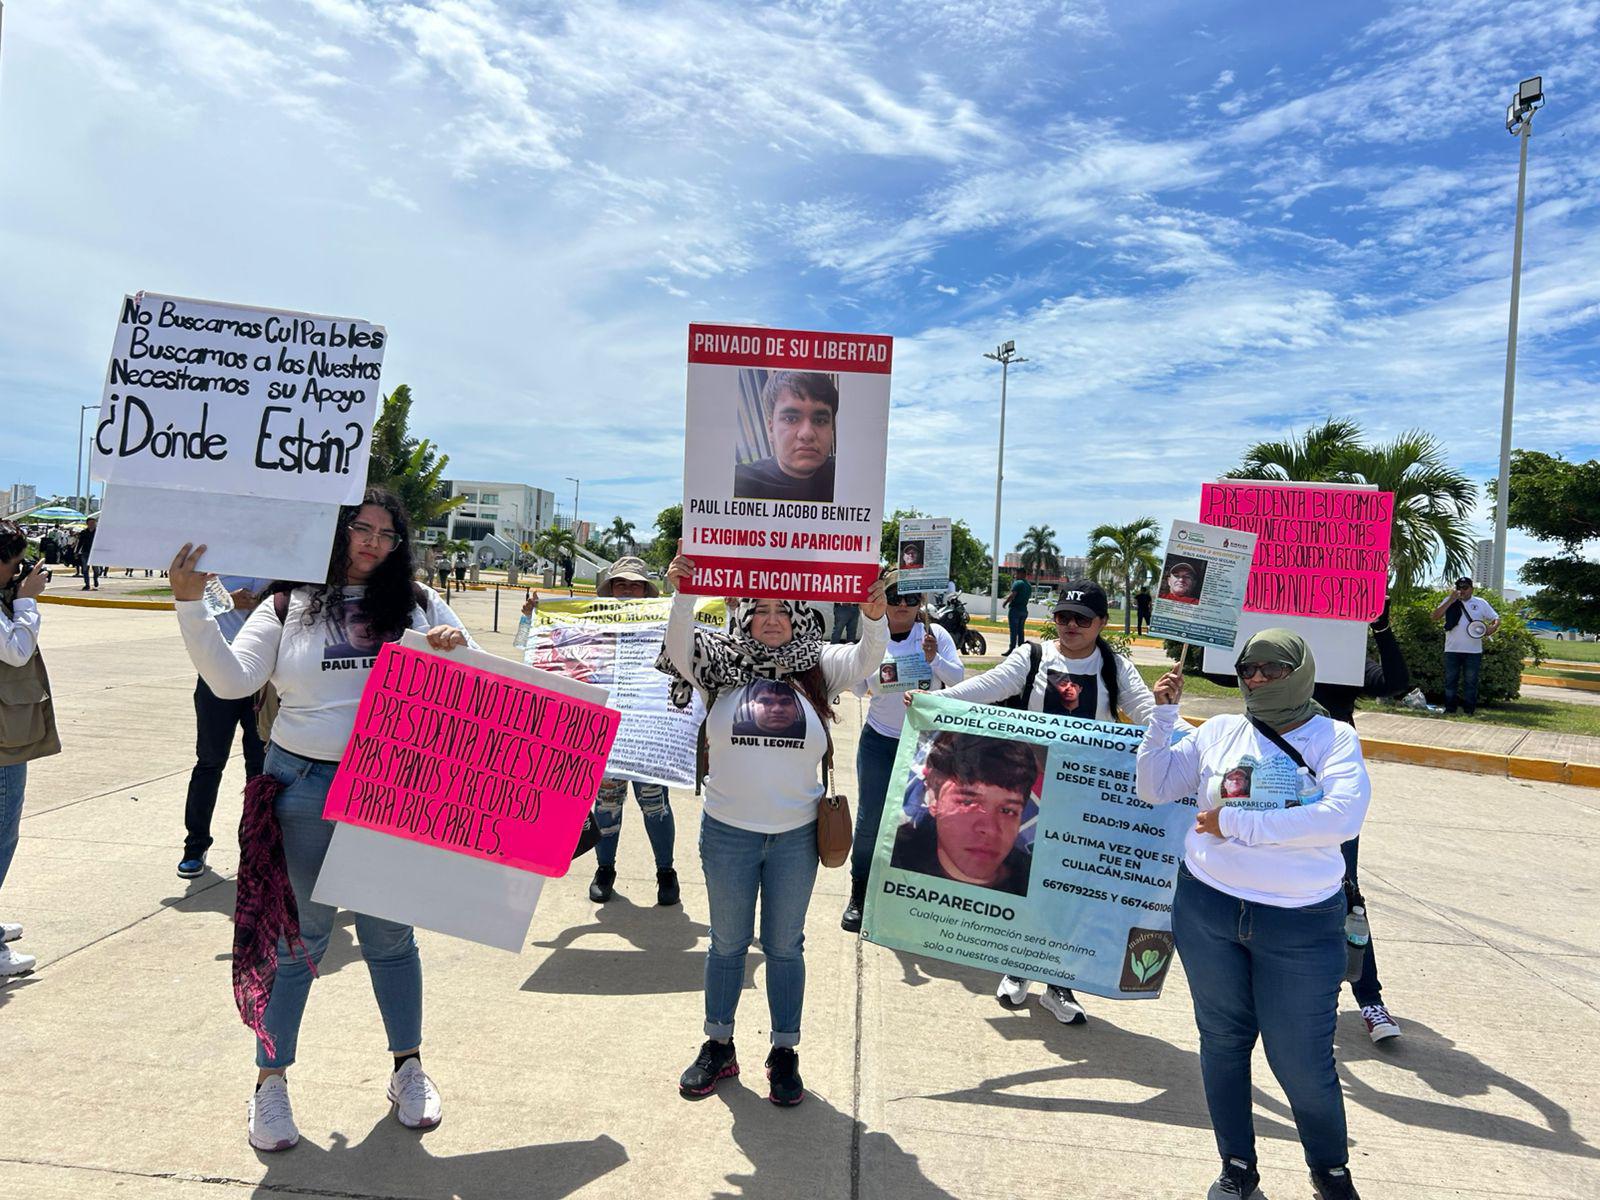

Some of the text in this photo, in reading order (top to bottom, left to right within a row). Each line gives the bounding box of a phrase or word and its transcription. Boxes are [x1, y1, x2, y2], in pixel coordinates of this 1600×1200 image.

[121, 298, 152, 325] No
[159, 301, 262, 339] Buscamos
[130, 327, 247, 370] Buscamos
[254, 355, 271, 371] a
[694, 333, 887, 363] PRIVADO DE SU LIBERTAD
[110, 359, 365, 412] Necesitamos su Apoyo
[96, 394, 363, 474] ¿Dónde Están?
[690, 499, 871, 522] PAUL LEONEL JACOBO BENITEZ
[1210, 486, 1387, 522] PRESIDENTA BUSCAMOS
[701, 528, 765, 547] EXIGIMOS
[770, 532, 787, 548] SU
[791, 532, 862, 552] APARICION
[1264, 518, 1346, 545] NECESITAMOS
[1274, 544, 1324, 568] BUSQUEDA
[1326, 547, 1334, 568] Y
[1336, 548, 1388, 572] RECURSOS
[692, 568, 862, 594] HASTA ENCONTRARTE
[1066, 591, 1085, 600] NY
[1245, 572, 1285, 612] QUEDA
[1287, 574, 1307, 613] NO
[321, 660, 358, 671] PAUL
[383, 650, 406, 692] EL
[466, 676, 500, 720] NO
[498, 685, 556, 738] TIENE
[934, 714, 984, 729] ADDIEL
[988, 721, 1056, 740] GERARDO
[1060, 732, 1126, 752] GALINDO
[968, 704, 1144, 738] AYÚDANOS A LOCALIZAR
[731, 736, 805, 749] PAUL LEONEL
[478, 728, 599, 800] NECESITAMOS
[1062, 761, 1080, 772] NO
[1082, 766, 1096, 774] SE
[1099, 768, 1130, 781] SABE
[384, 745, 446, 794] MANOS
[445, 763, 460, 798] Y
[459, 767, 543, 824] RECURSOS
[1056, 772, 1094, 786] DESDE
[1098, 780, 1111, 790] EL
[1114, 782, 1128, 793] 03
[344, 778, 396, 826] PARA
[1101, 792, 1154, 810] DEL 2024
[1082, 812, 1166, 838] EDAD:19 AÑOS
[1045, 830, 1059, 840] LA
[1062, 832, 1106, 850] ÚLTIMA
[1109, 842, 1131, 856] VEZ
[1134, 848, 1158, 861] QUE
[1161, 855, 1174, 864] SE
[1100, 854, 1140, 870] FUE EN
[883, 880, 1016, 921] DESAPARECIDO
[1042, 878, 1172, 912] 6676792255 Y 667460106
[909, 907, 1096, 958] Cualquier información será anónima.
[939, 928, 1062, 964] No buscamos culpables,
[923, 940, 1076, 981] solo a nuestros desaparecidos
